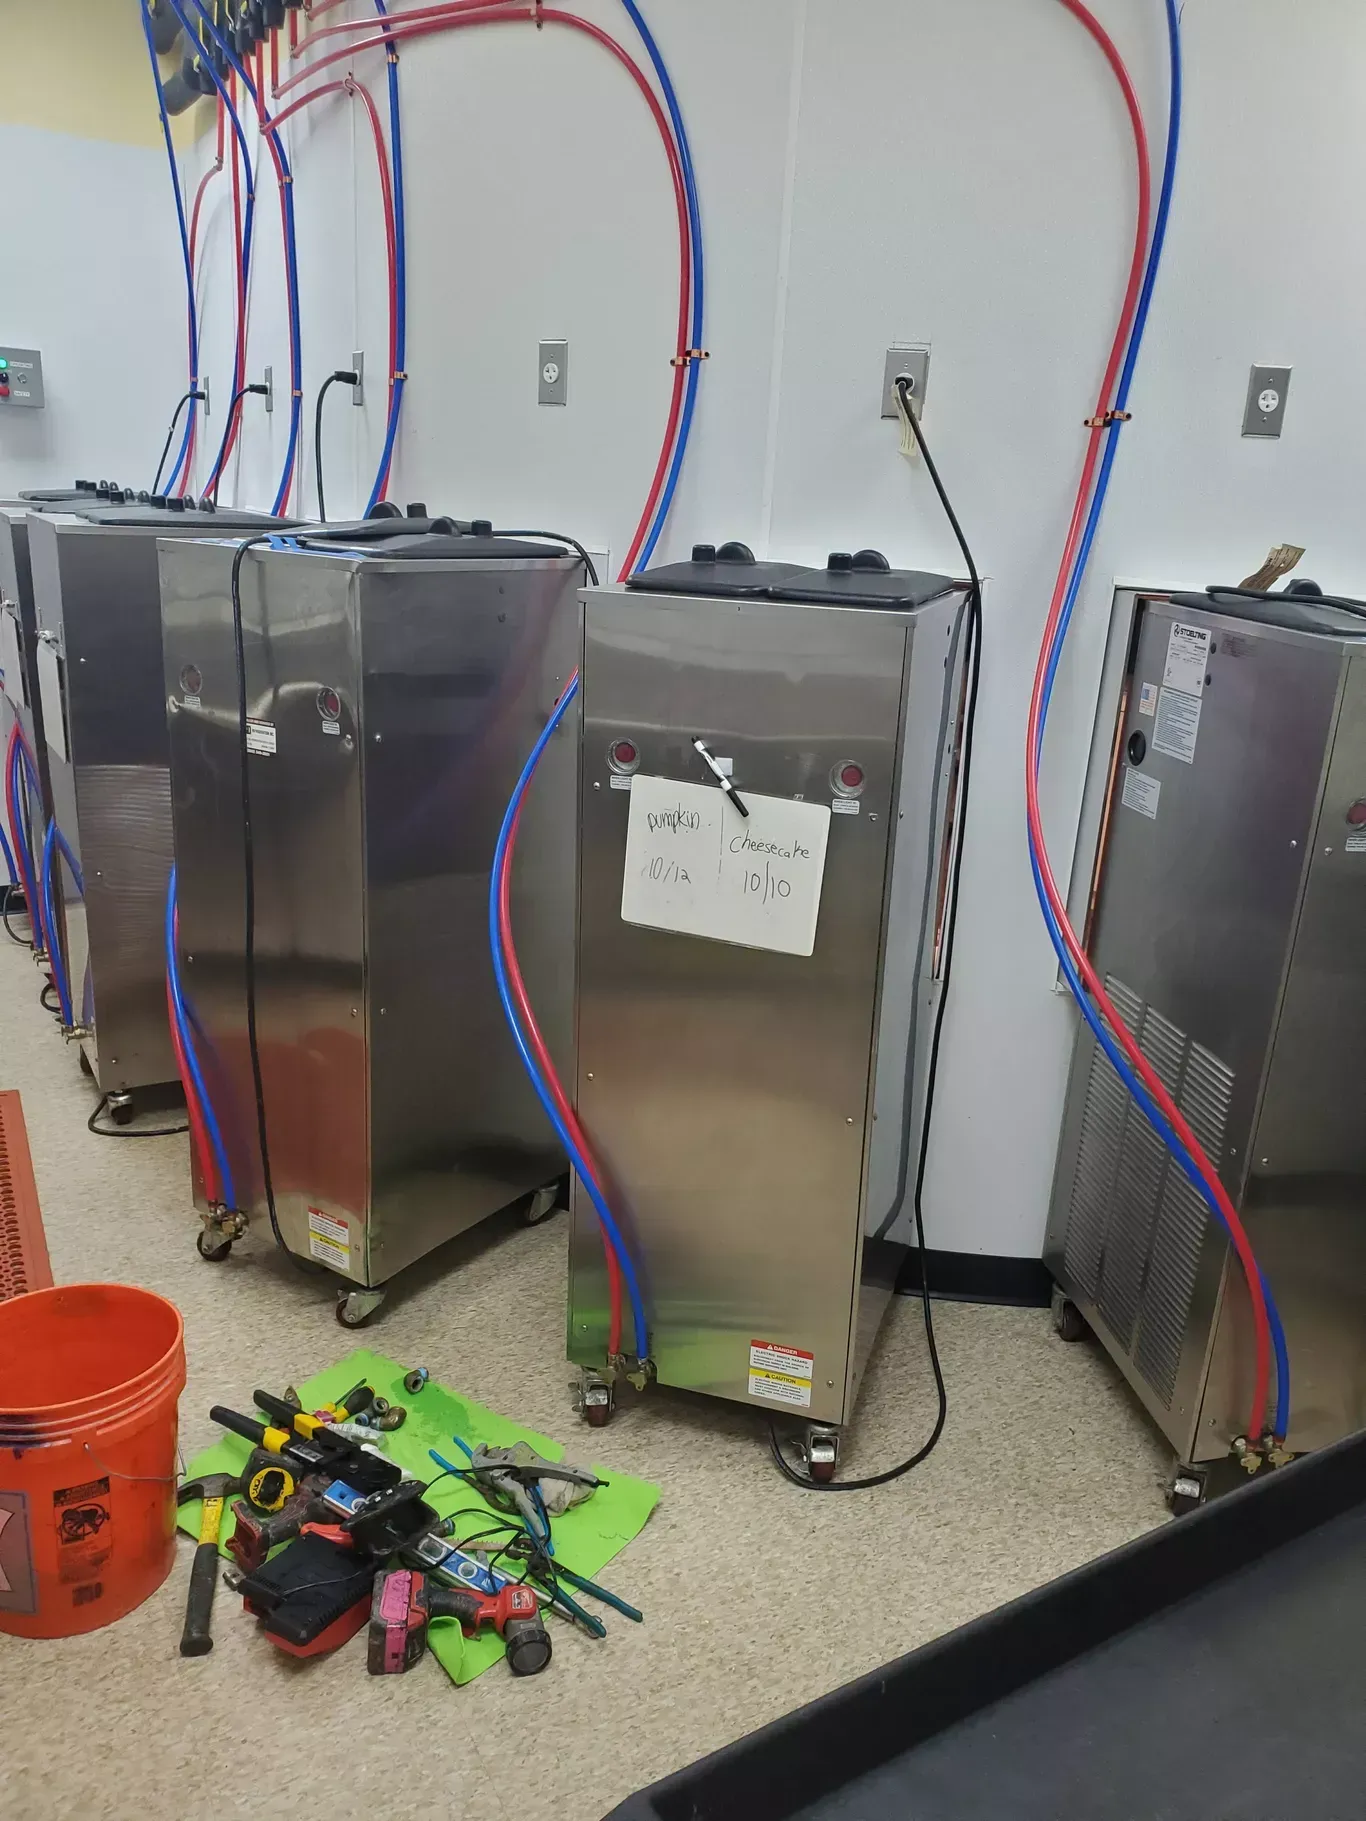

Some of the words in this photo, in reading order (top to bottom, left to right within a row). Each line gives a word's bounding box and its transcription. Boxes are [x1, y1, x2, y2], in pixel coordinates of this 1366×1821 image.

[1180, 628, 1206, 640] STOELTING
[647, 803, 700, 833] pumpkin
[743, 861, 791, 905] 10/10
[774, 1346, 798, 1355] DANGER
[772, 1374, 796, 1384] CAUTION
